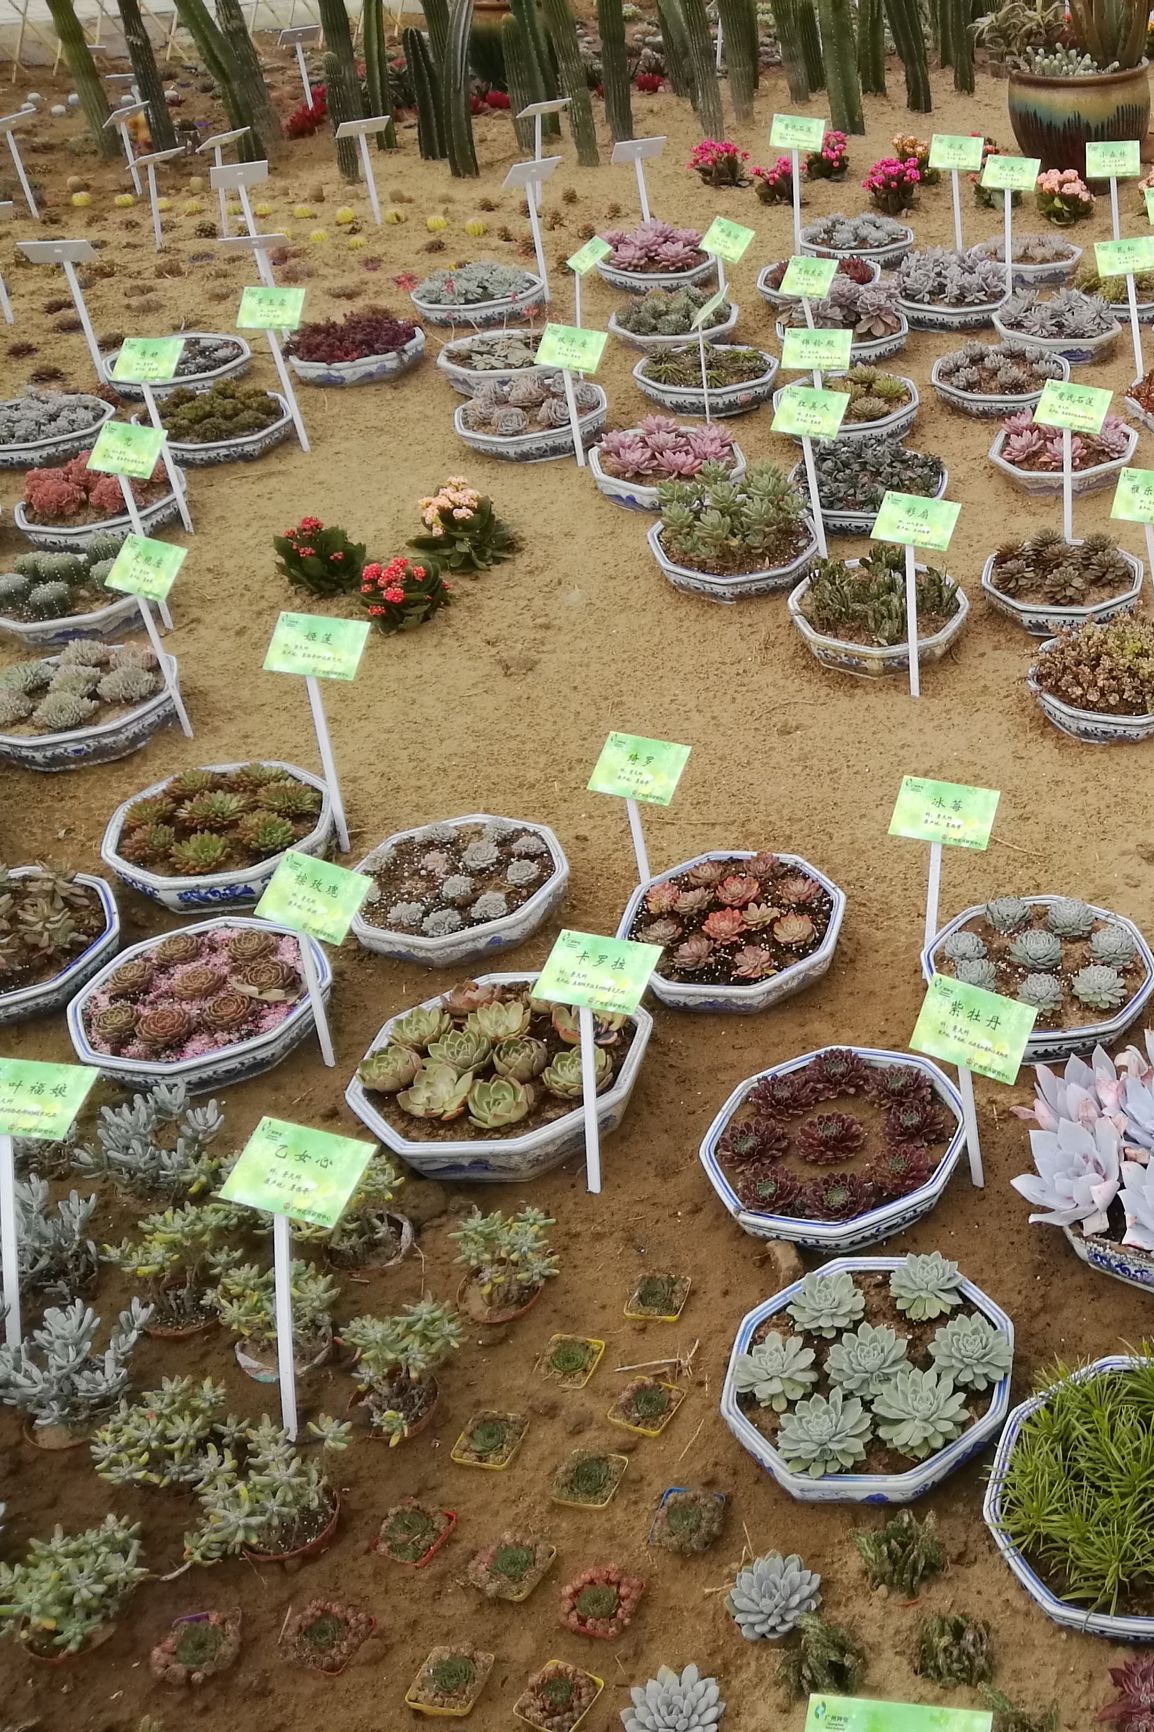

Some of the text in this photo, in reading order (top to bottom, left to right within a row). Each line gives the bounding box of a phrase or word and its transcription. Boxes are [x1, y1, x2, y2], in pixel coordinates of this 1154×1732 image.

[574, 950, 627, 970] 卡罗拉
[949, 999, 1002, 1030] 紫牡丹
[274, 1144, 334, 1170] 乙女心
